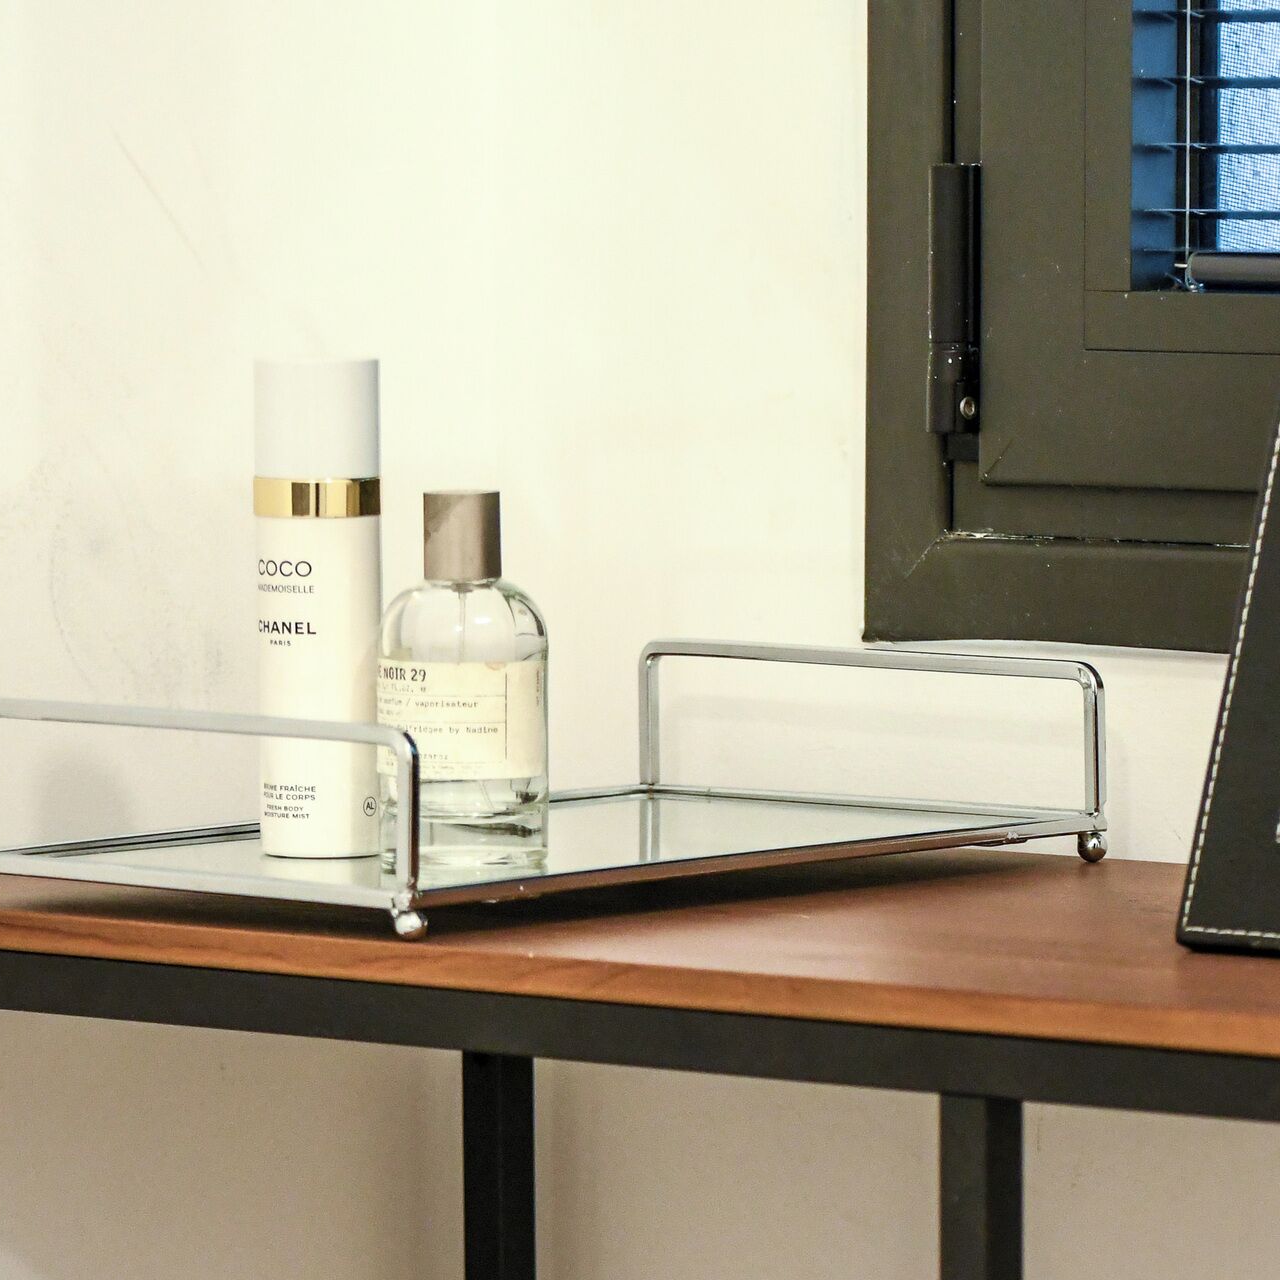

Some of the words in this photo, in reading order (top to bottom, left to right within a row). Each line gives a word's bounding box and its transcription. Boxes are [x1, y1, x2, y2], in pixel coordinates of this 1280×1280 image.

[258, 559, 312, 577] COCO
[258, 619, 317, 635] CHANEL
[270, 639, 291, 647] PARIS
[383, 666, 406, 681] NOIR
[410, 668, 427, 682] 29
[449, 726, 460, 735] by
[466, 726, 498, 734] Nadine
[275, 793, 283, 801] LE
